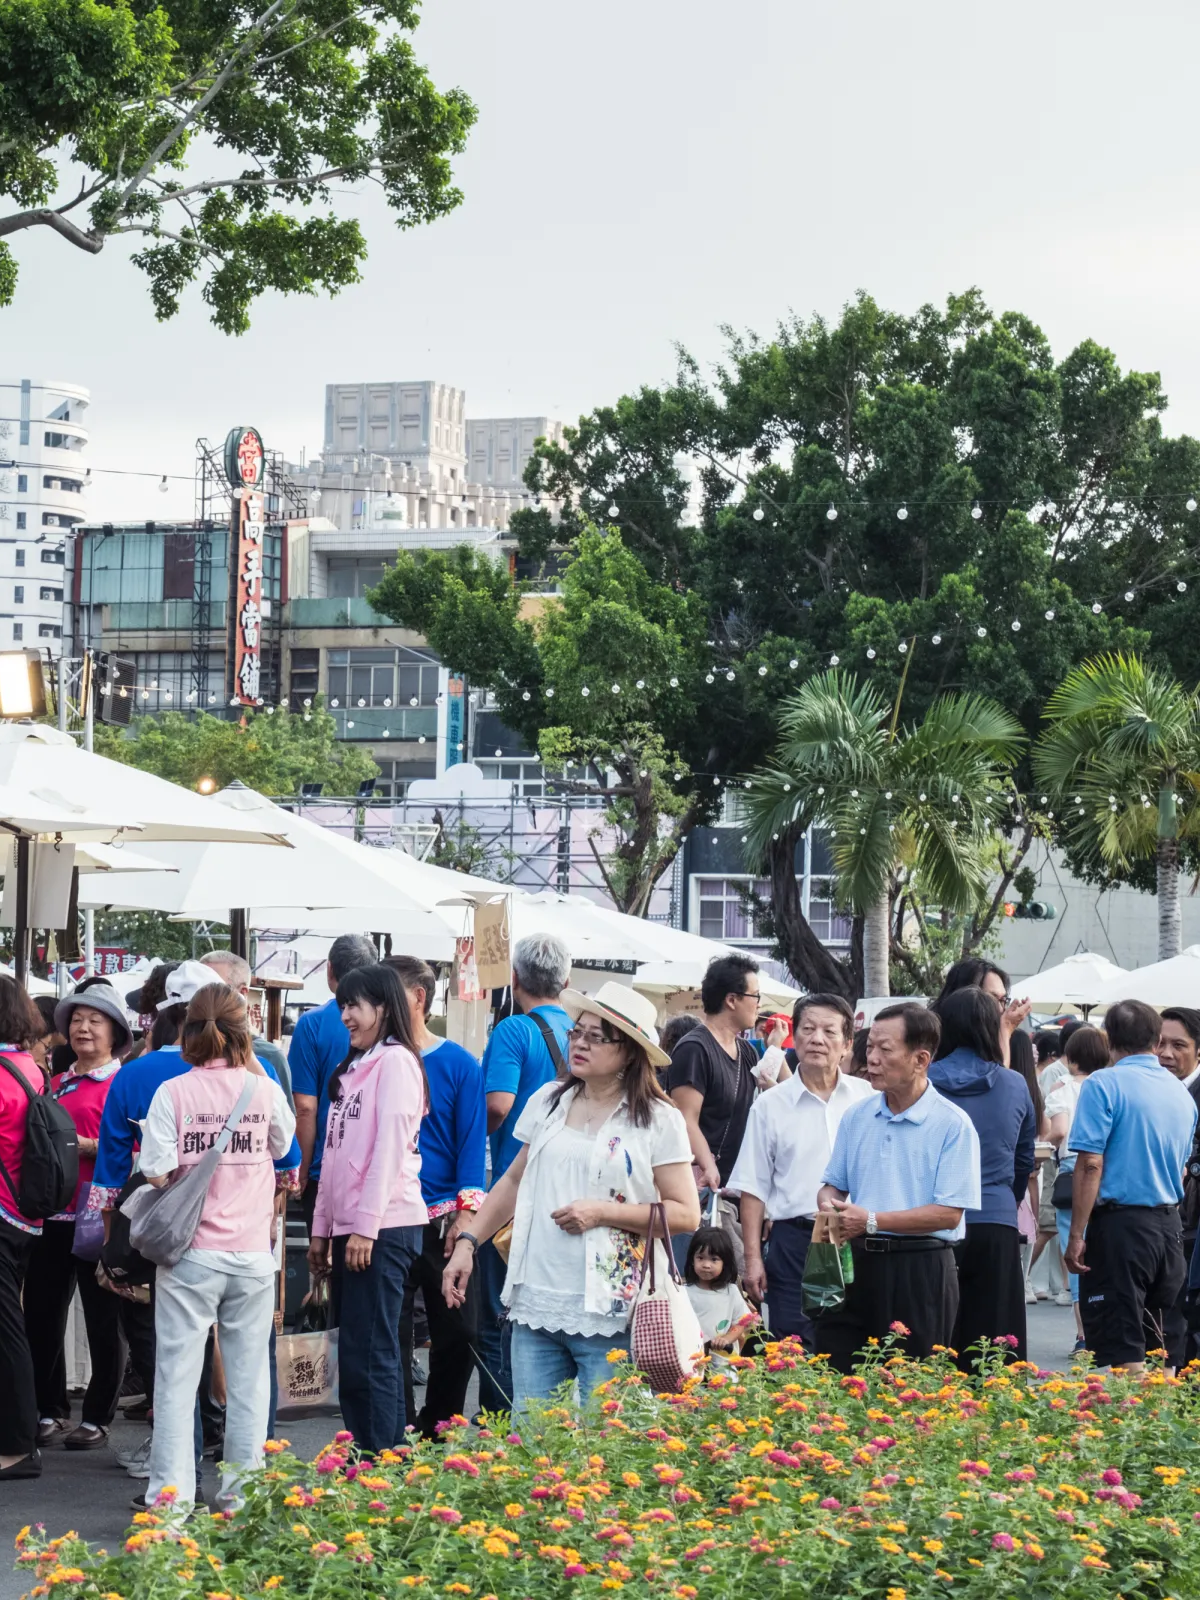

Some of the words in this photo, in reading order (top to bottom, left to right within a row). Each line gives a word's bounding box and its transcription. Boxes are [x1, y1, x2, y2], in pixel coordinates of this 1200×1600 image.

[238, 431, 262, 484] 當
[215, 1113, 266, 1124] 市候選人
